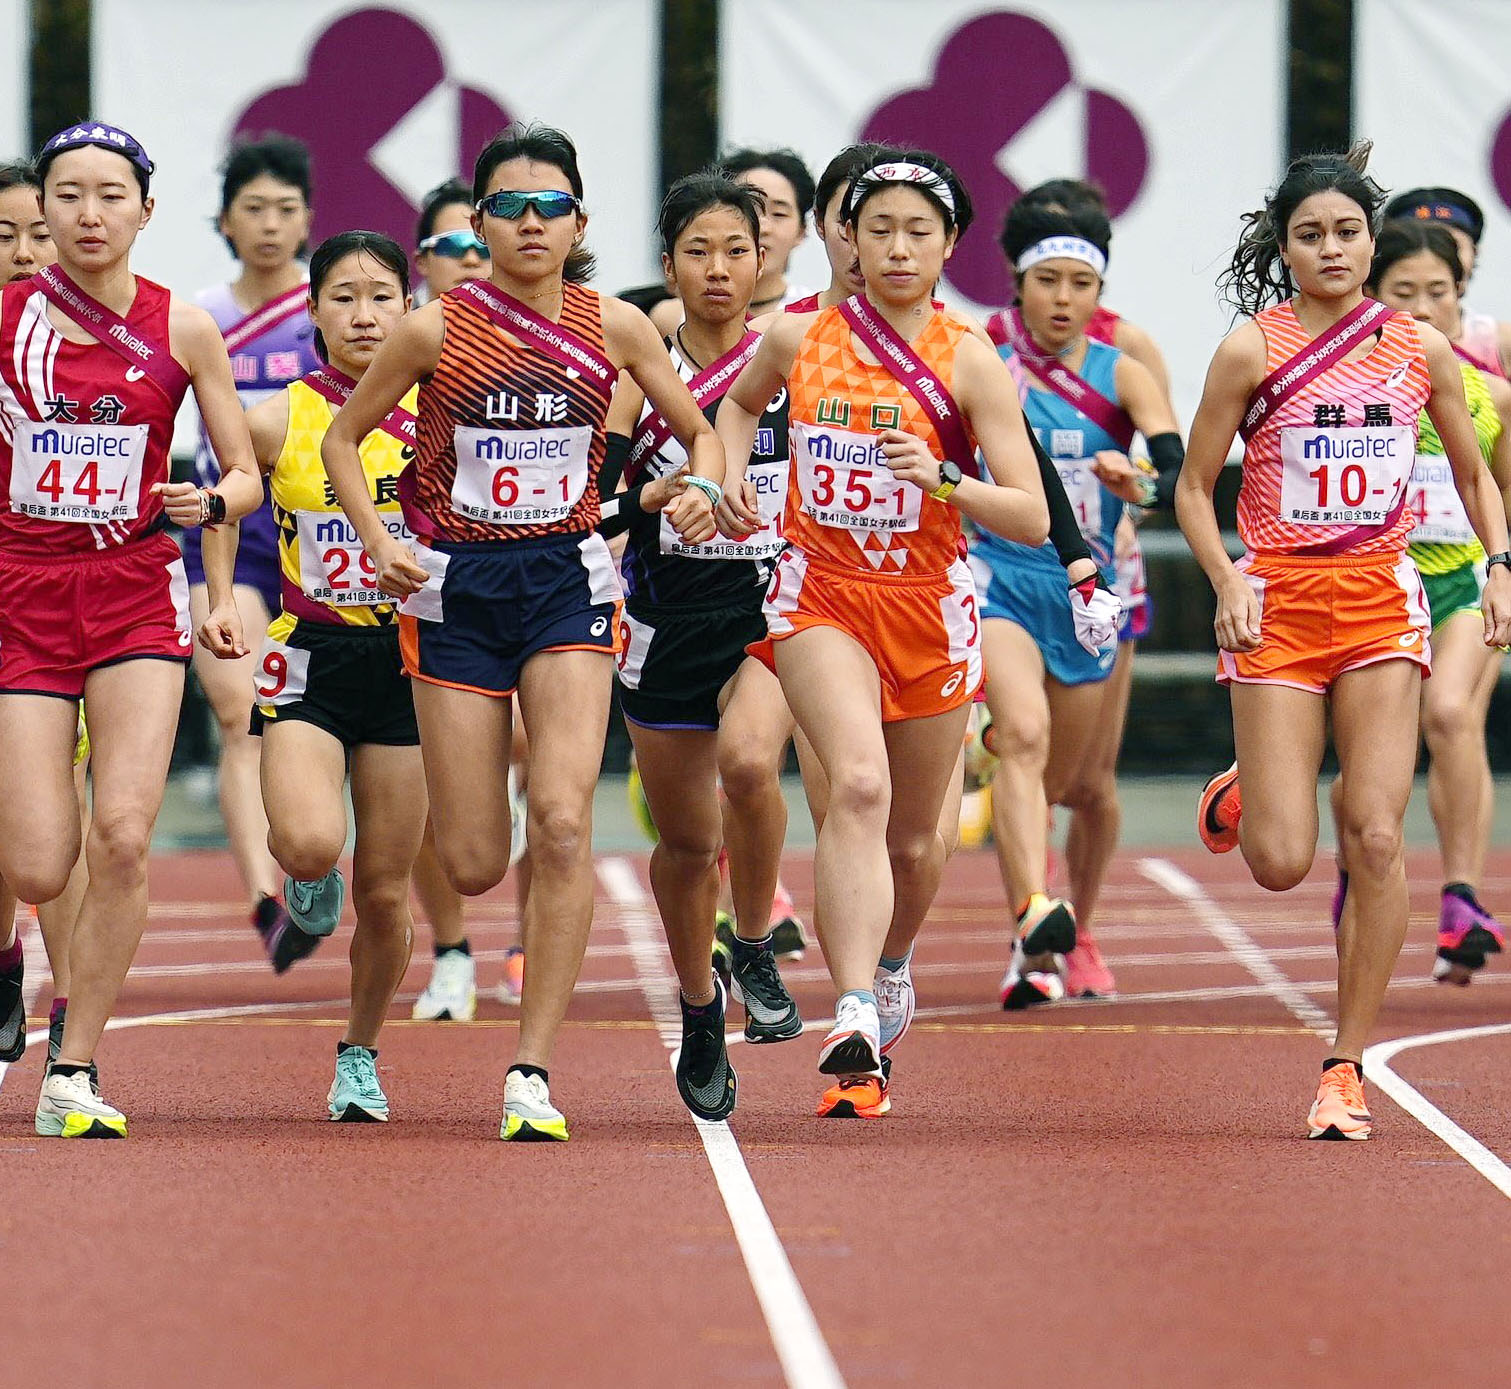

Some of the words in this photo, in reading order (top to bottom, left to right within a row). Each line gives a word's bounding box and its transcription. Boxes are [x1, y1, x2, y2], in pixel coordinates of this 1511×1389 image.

[54, 127, 126, 148] 大分東明
[231, 352, 300, 382] 山梨
[43, 393, 126, 424] 大分
[486, 391, 568, 422] 山形
[816, 397, 902, 431] 山口
[1313, 403, 1393, 428] 群馬
[492, 466, 569, 508] 6-1
[812, 464, 905, 516] 35-1
[1309, 464, 1402, 508] 10-1
[258, 651, 288, 698] 9
